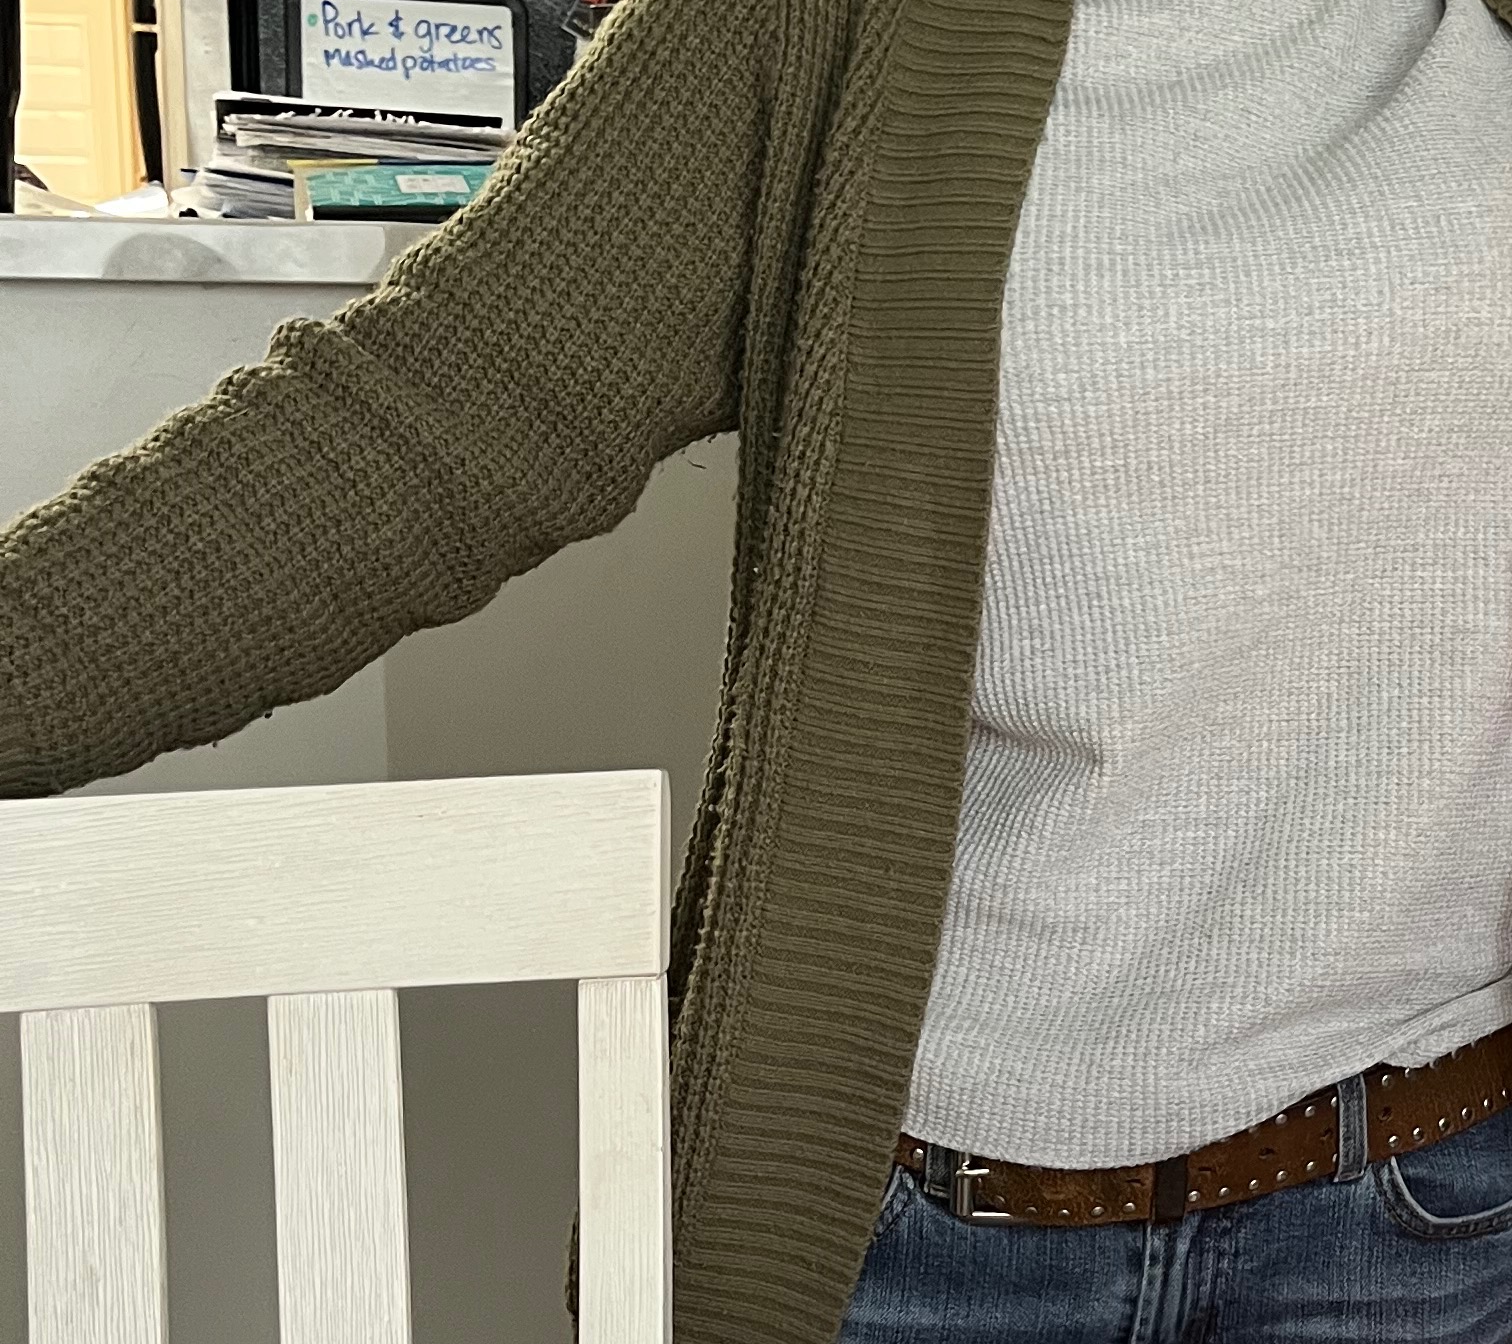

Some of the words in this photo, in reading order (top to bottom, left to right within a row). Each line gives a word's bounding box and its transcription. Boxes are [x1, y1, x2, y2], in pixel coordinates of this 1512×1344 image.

[321, 0, 379, 41] Pork
[388, 9, 404, 40] &
[414, 19, 503, 53] greens
[401, 52, 496, 81] potatoes
